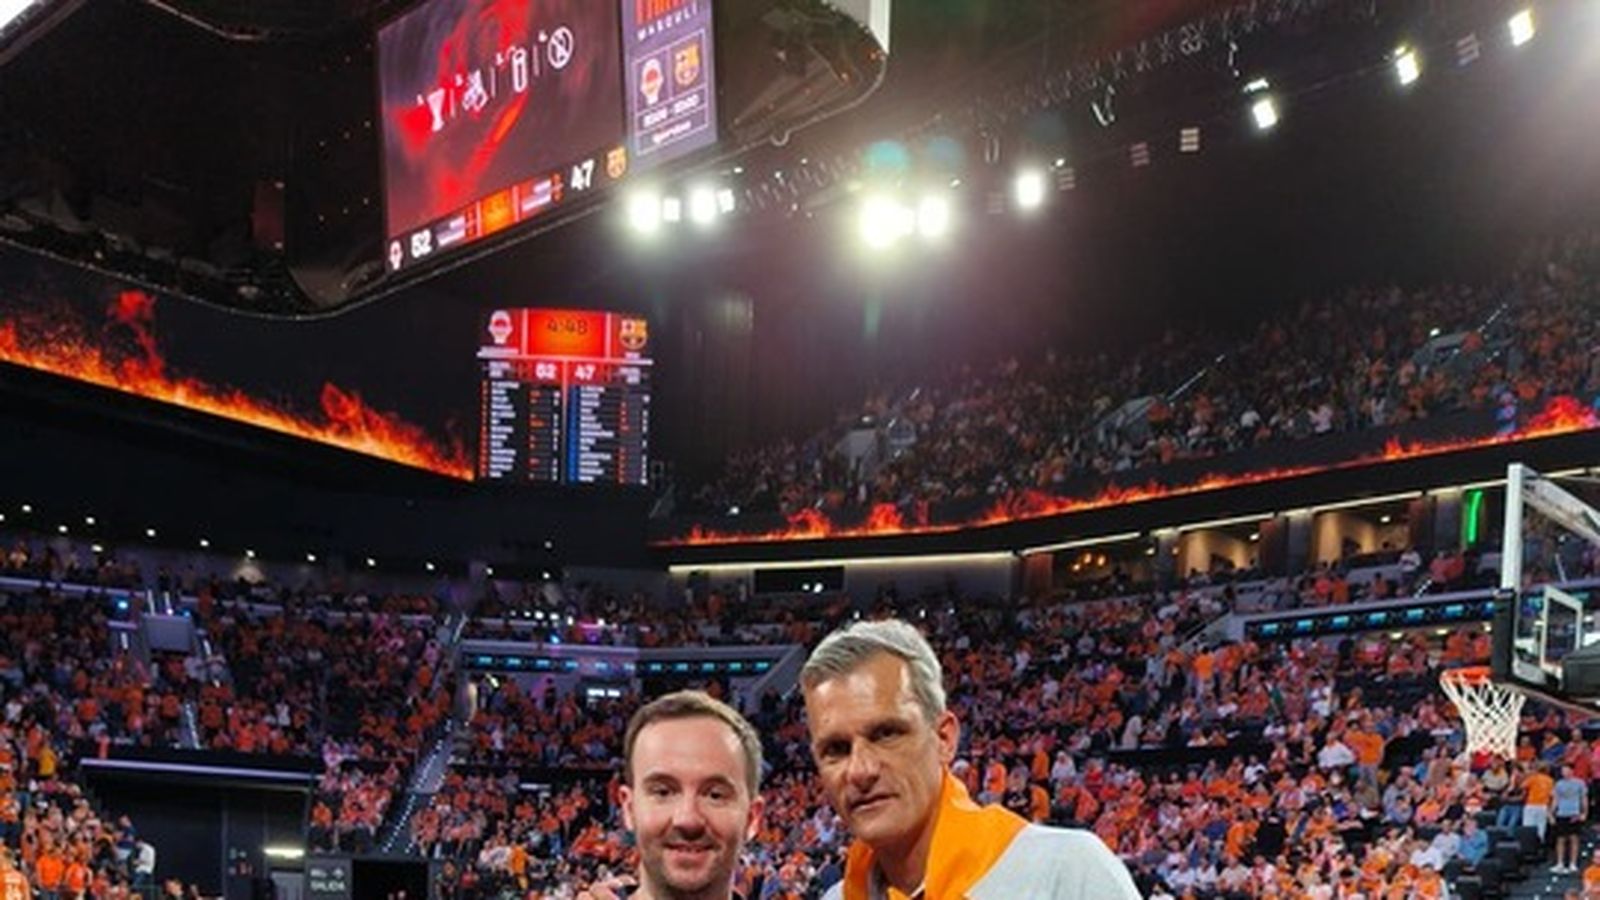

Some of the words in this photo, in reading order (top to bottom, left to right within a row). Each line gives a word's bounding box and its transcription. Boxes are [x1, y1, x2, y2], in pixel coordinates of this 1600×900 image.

[570, 158, 594, 190] 47
[410, 229, 433, 258] 52
[574, 364, 597, 380] 47
